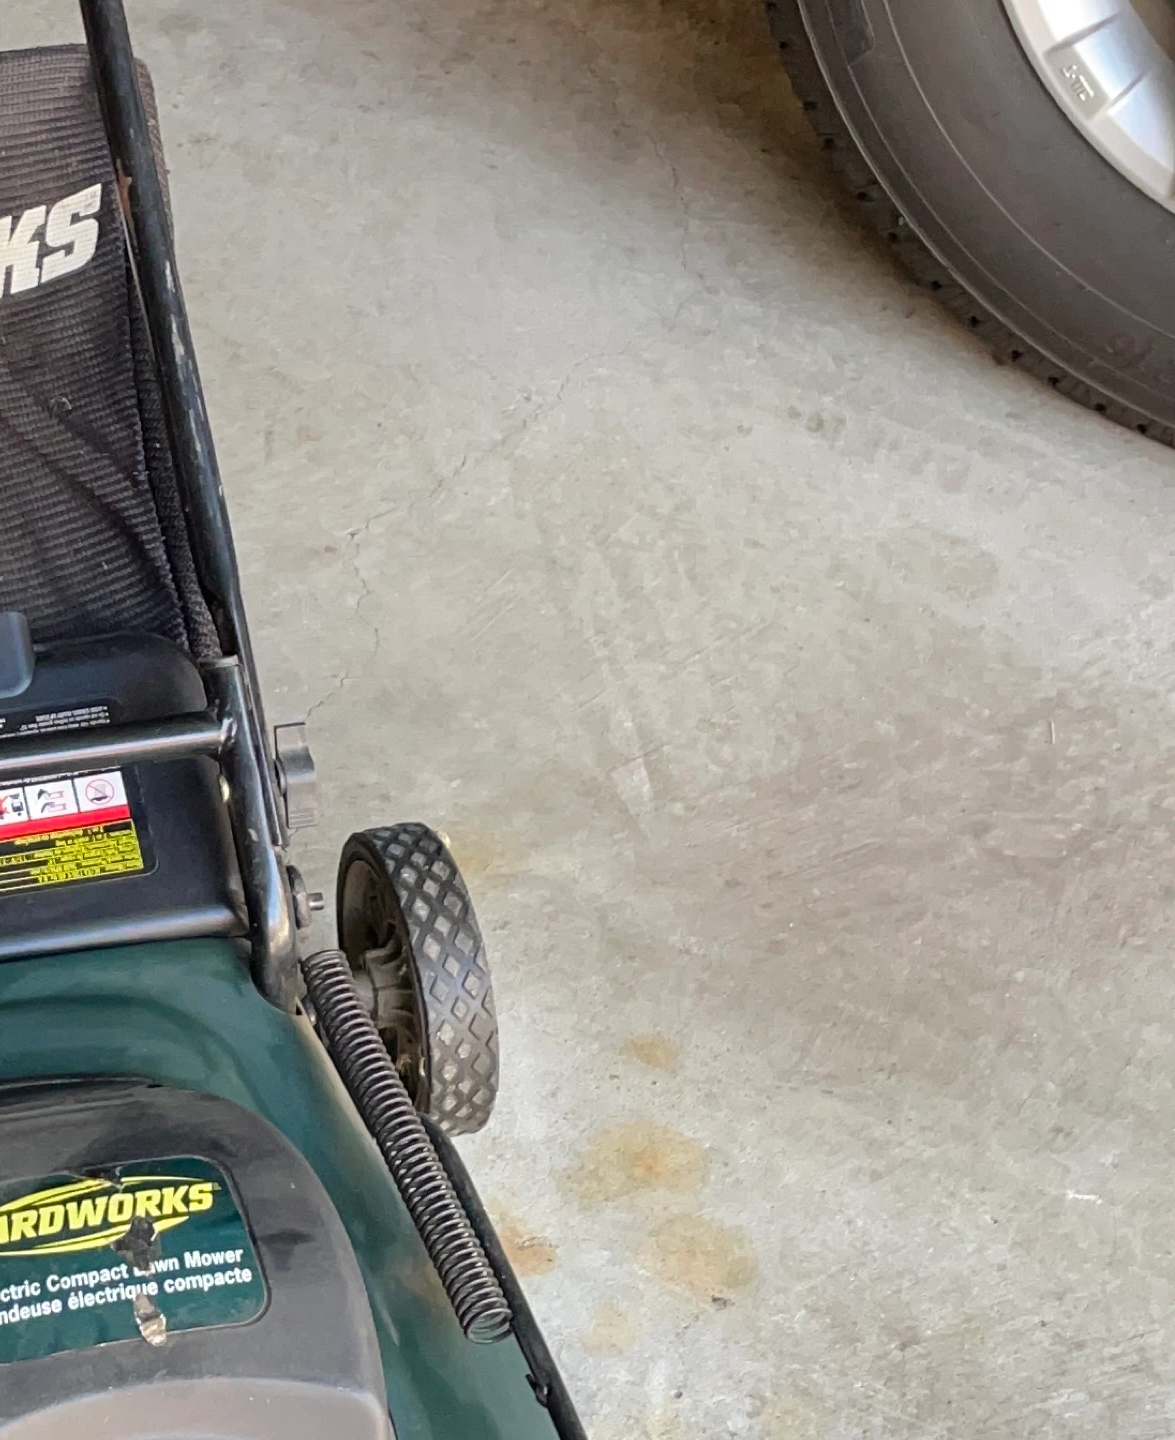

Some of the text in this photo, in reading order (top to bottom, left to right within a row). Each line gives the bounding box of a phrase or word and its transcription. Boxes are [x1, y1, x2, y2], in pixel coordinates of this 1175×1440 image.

[45, 1264, 130, 1292] Compact
[183, 1248, 244, 1269] Mower
[67, 1280, 159, 1312] électrique
[163, 1266, 253, 1294] compacte
